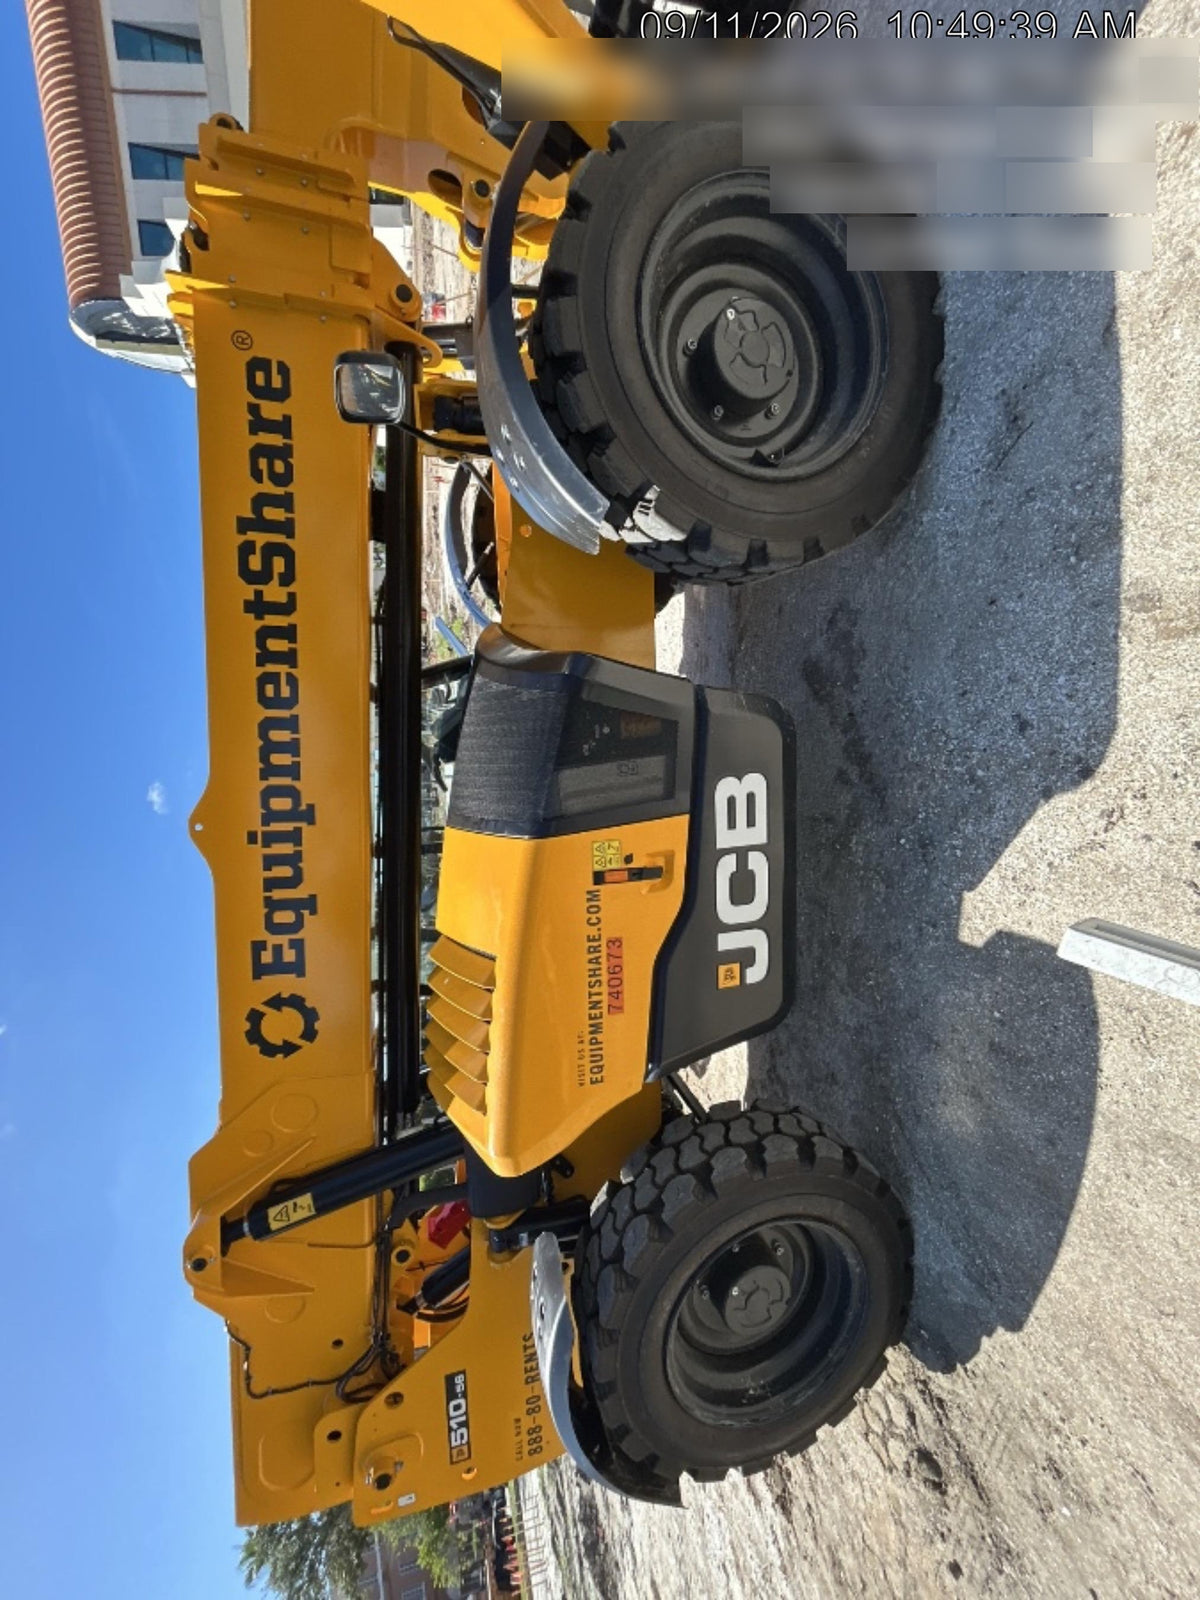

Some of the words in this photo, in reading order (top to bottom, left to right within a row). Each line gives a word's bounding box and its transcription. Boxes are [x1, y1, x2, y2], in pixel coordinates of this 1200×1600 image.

[714, 773, 769, 984] JCB
[586, 889, 605, 1085] EQUIPMENTSHARE.COM
[606, 938, 624, 1014] 740673
[522, 1332, 543, 1457] 888-80-RENTS
